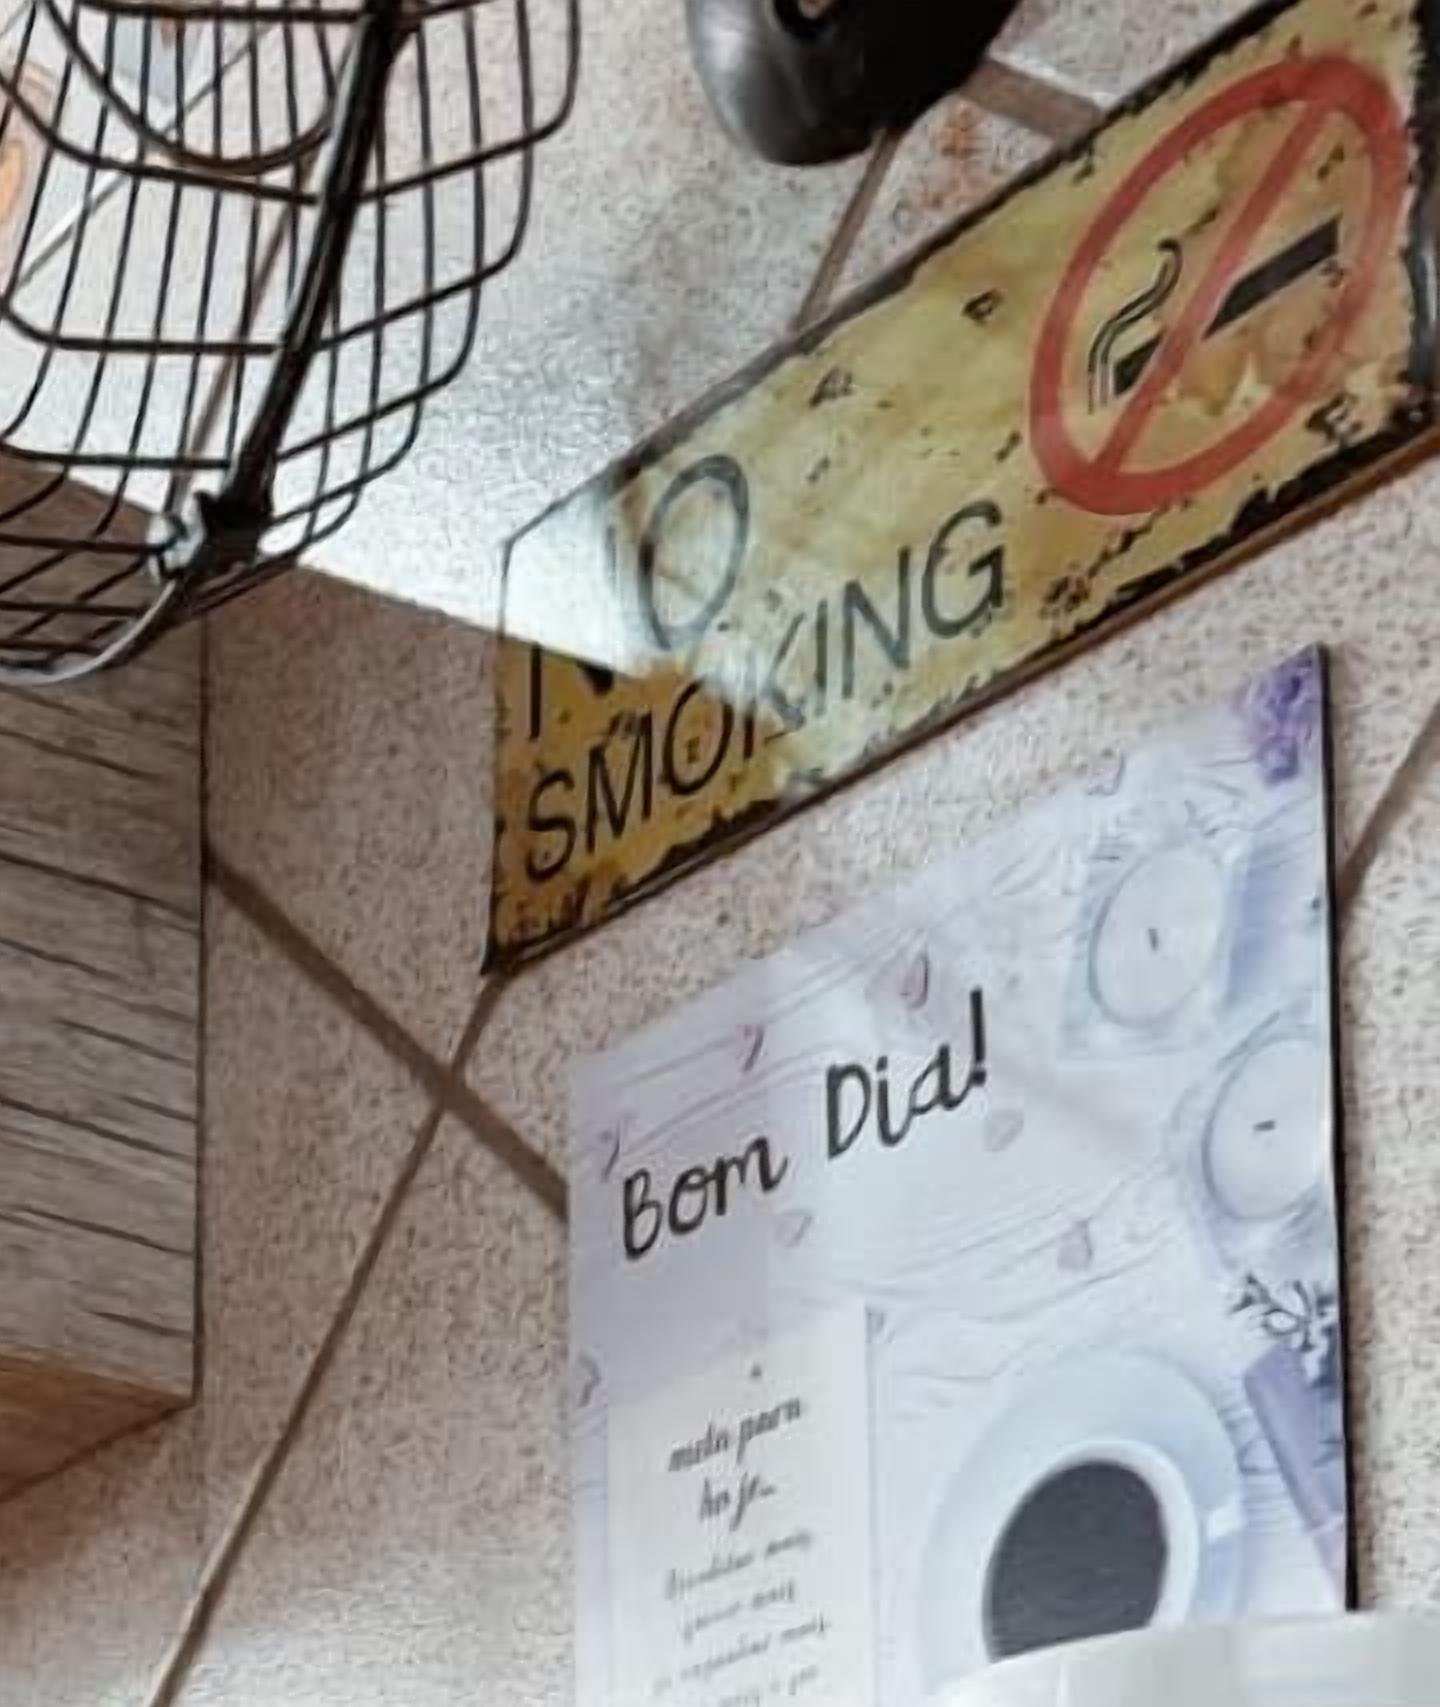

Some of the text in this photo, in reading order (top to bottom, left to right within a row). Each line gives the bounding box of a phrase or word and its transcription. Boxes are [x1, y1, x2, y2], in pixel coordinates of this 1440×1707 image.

[524, 500, 1005, 882] SMOKING
[623, 986, 987, 1260] Bom Dia!
